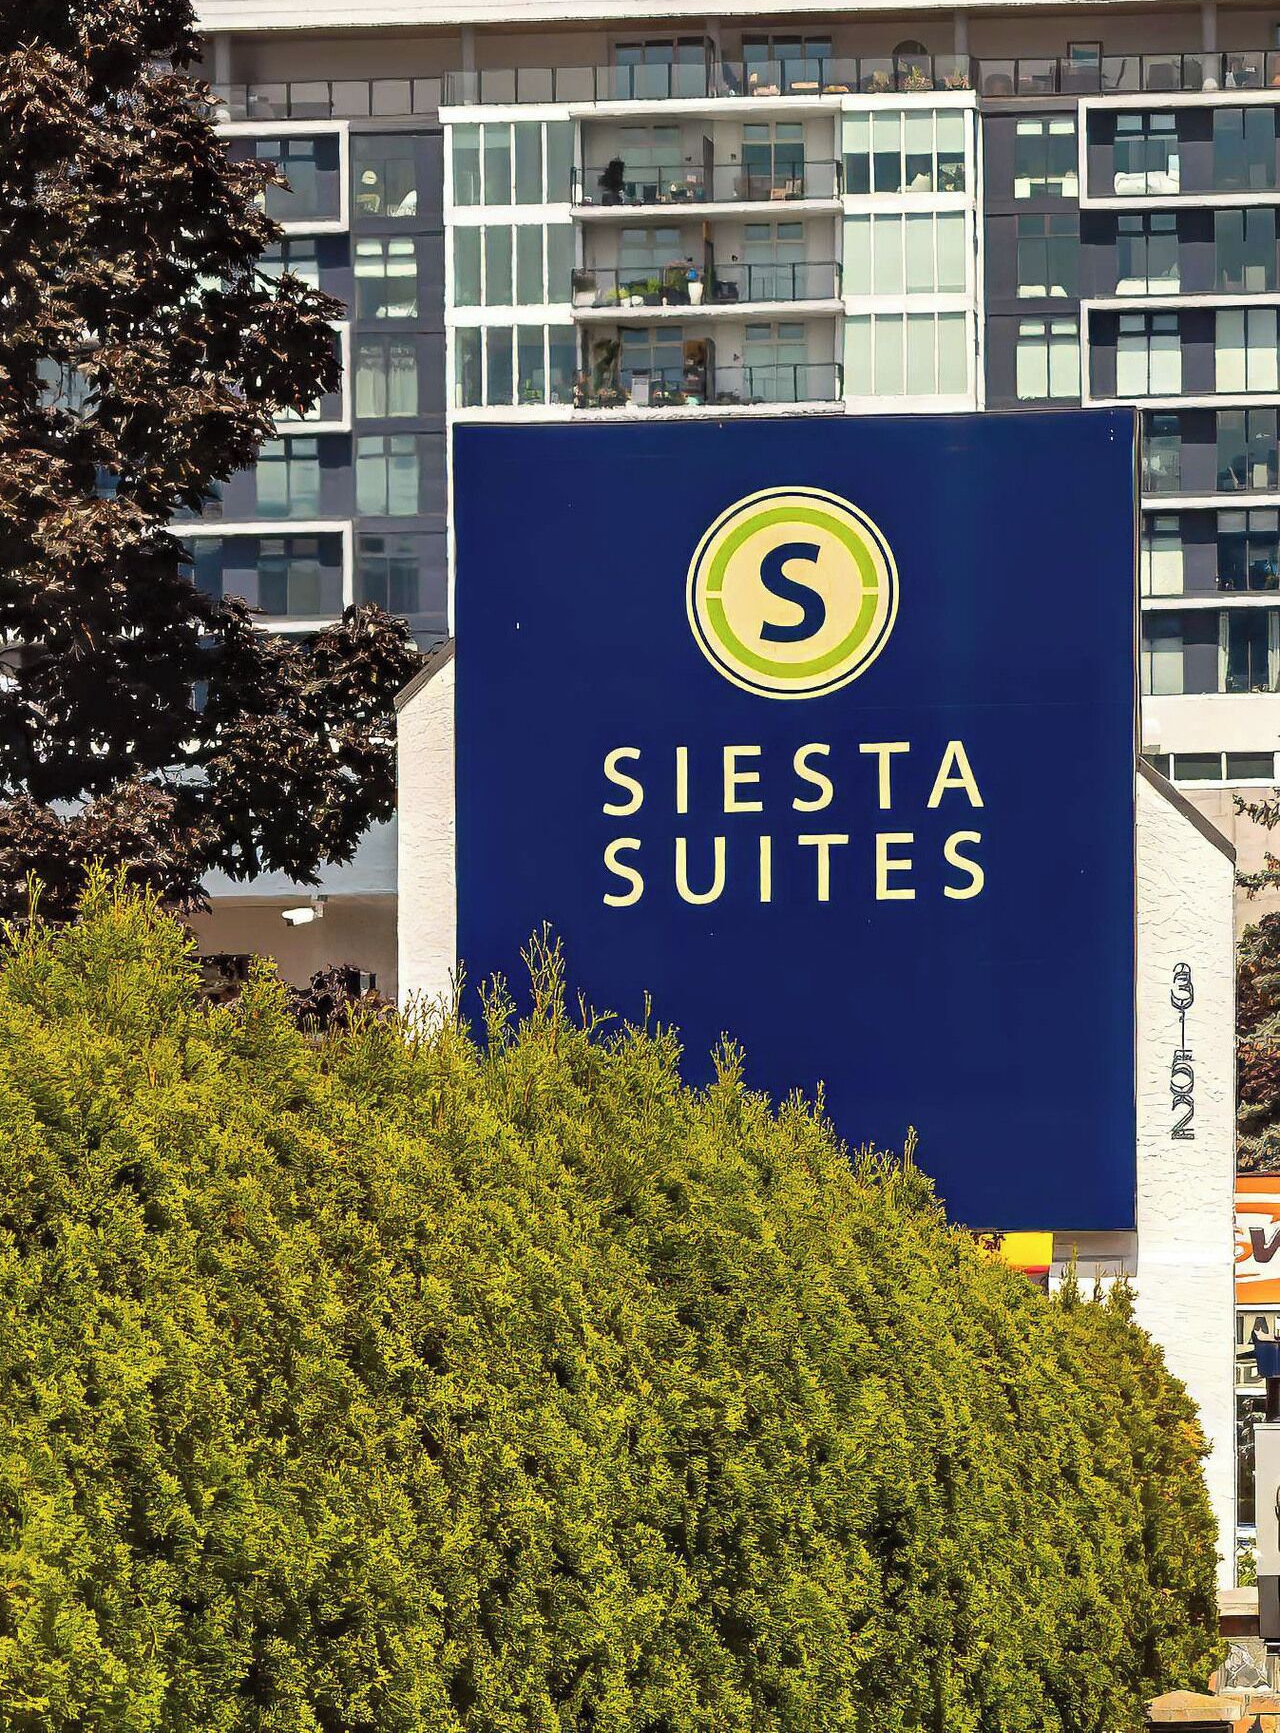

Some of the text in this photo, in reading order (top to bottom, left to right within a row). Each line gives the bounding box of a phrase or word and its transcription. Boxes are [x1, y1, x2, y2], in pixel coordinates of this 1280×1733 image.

[760, 543, 825, 642] S
[603, 741, 984, 816] SIESTA
[603, 831, 984, 907] SUITES
